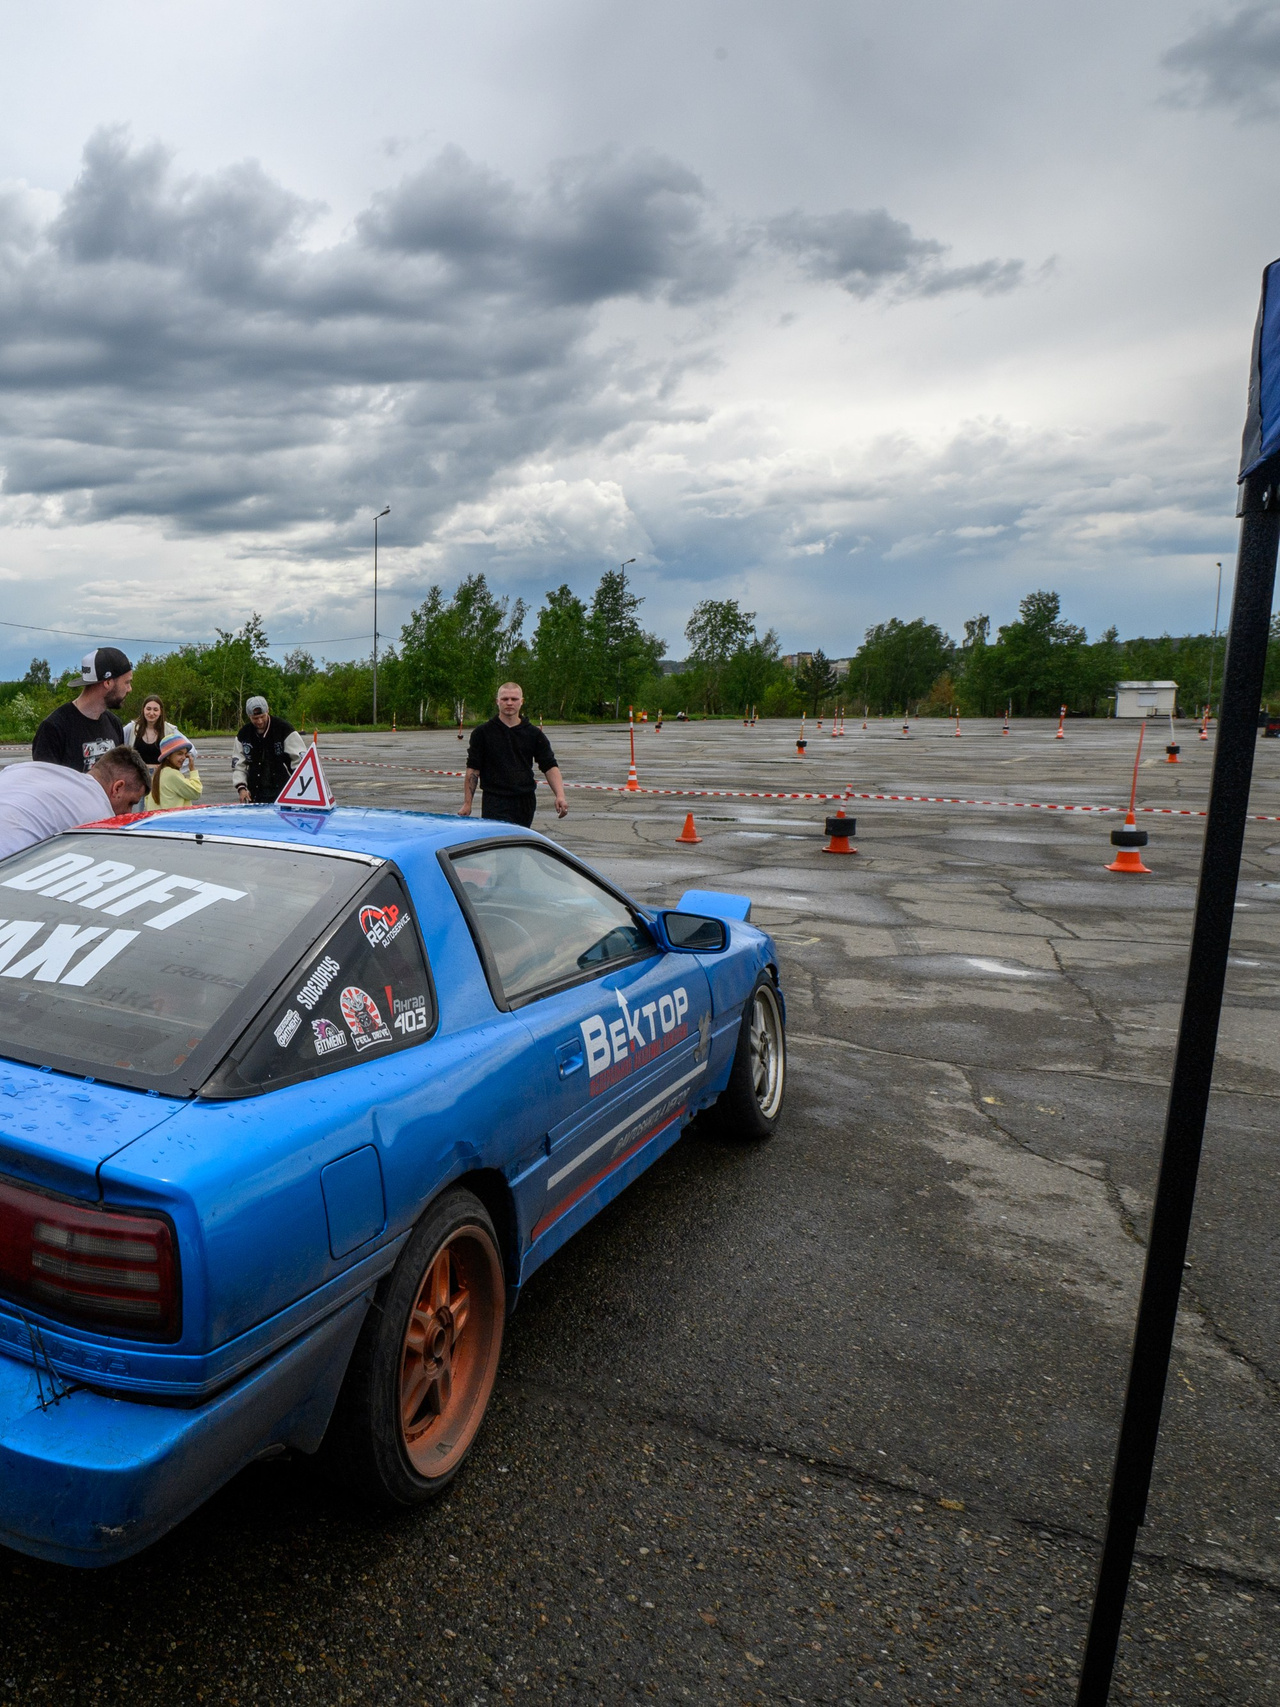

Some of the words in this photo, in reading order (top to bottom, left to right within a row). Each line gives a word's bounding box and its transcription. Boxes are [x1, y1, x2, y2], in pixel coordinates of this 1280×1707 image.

[0, 852, 249, 931] DRIFT
[296, 955, 340, 1010] SIDEWAYS
[394, 1006, 426, 1035] 403
[315, 1033, 346, 1054] FITMENT
[354, 1034, 372, 1047] FEEL
[371, 1028, 390, 1041] DRIVE
